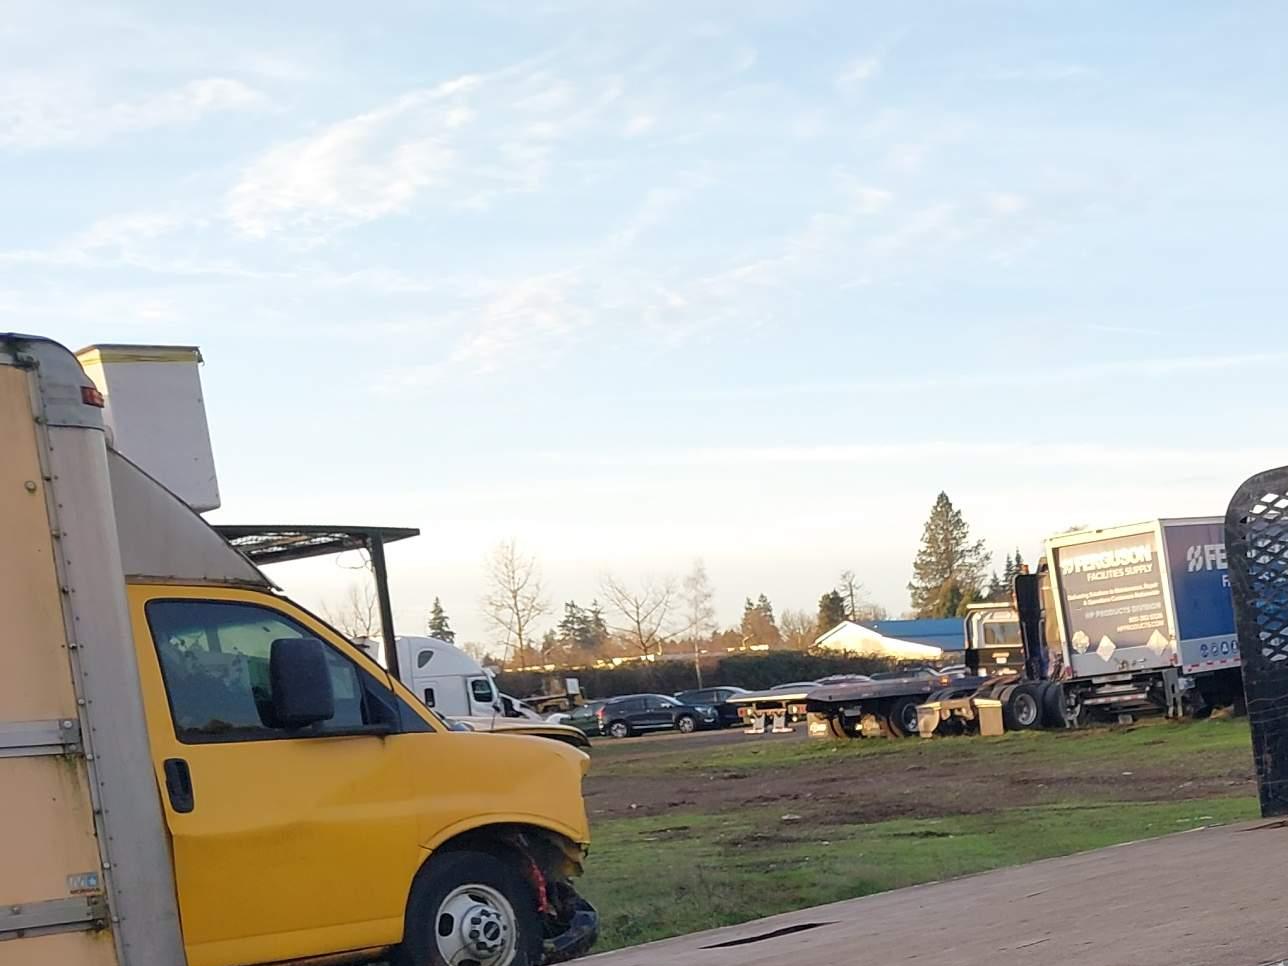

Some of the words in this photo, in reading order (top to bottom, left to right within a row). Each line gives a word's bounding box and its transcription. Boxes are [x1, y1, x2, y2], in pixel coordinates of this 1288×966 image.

[1074, 545, 1152, 573] FERGUSON
[1086, 567, 1125, 582] FACILITIES
[1124, 563, 1153, 576] SUPPLY
